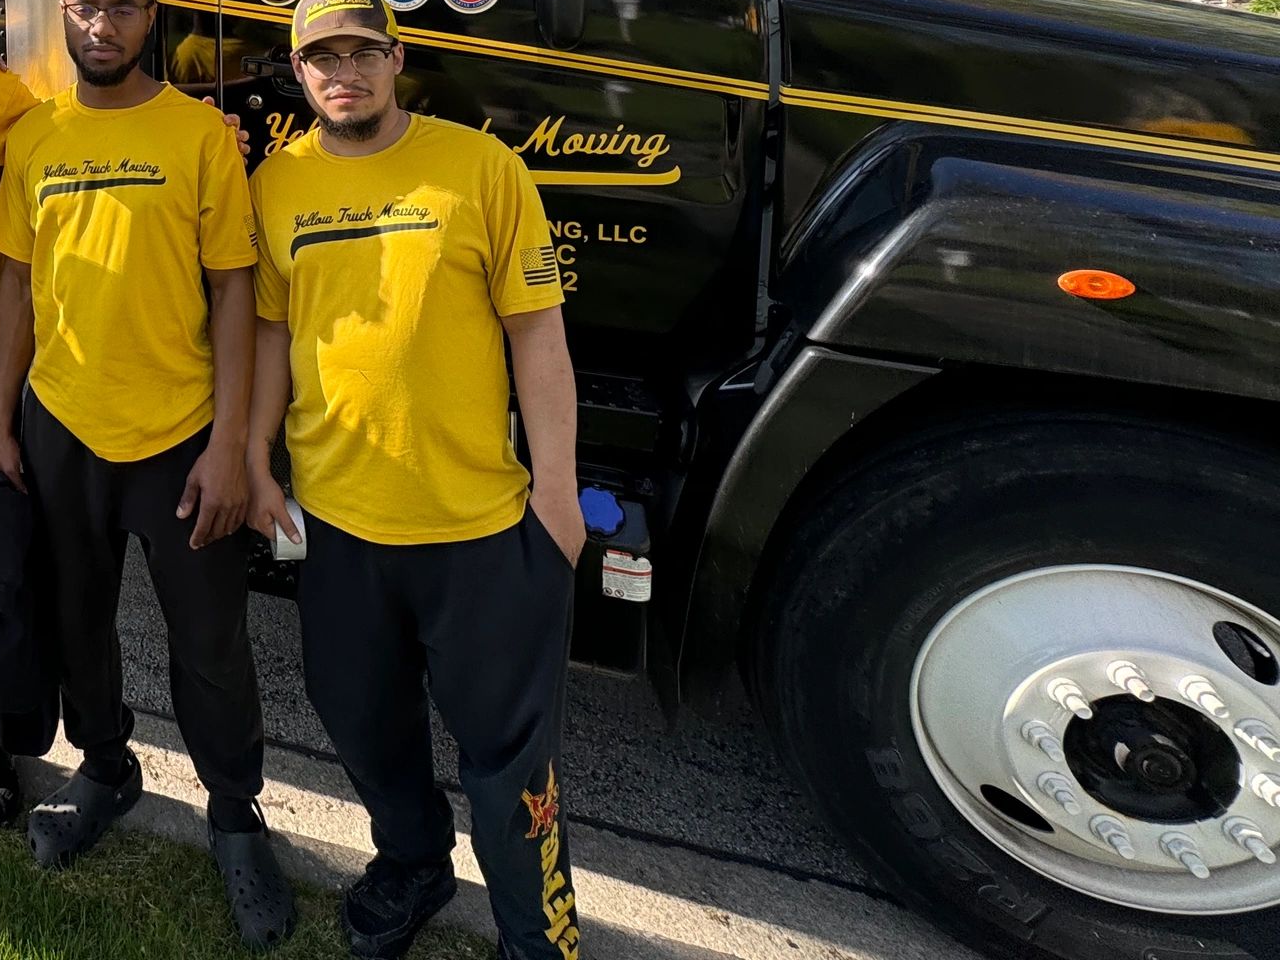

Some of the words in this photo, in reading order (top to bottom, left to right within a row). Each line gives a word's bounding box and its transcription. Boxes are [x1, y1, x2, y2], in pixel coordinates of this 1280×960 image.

[513, 115, 670, 168] Moving
[42, 162, 78, 183] Yellow
[80, 159, 112, 175] Truck
[114, 157, 161, 177] Moving
[293, 210, 334, 233] Yellow
[336, 205, 373, 224] Truck
[375, 201, 431, 221] Moving
[598, 223, 648, 244] LLC
